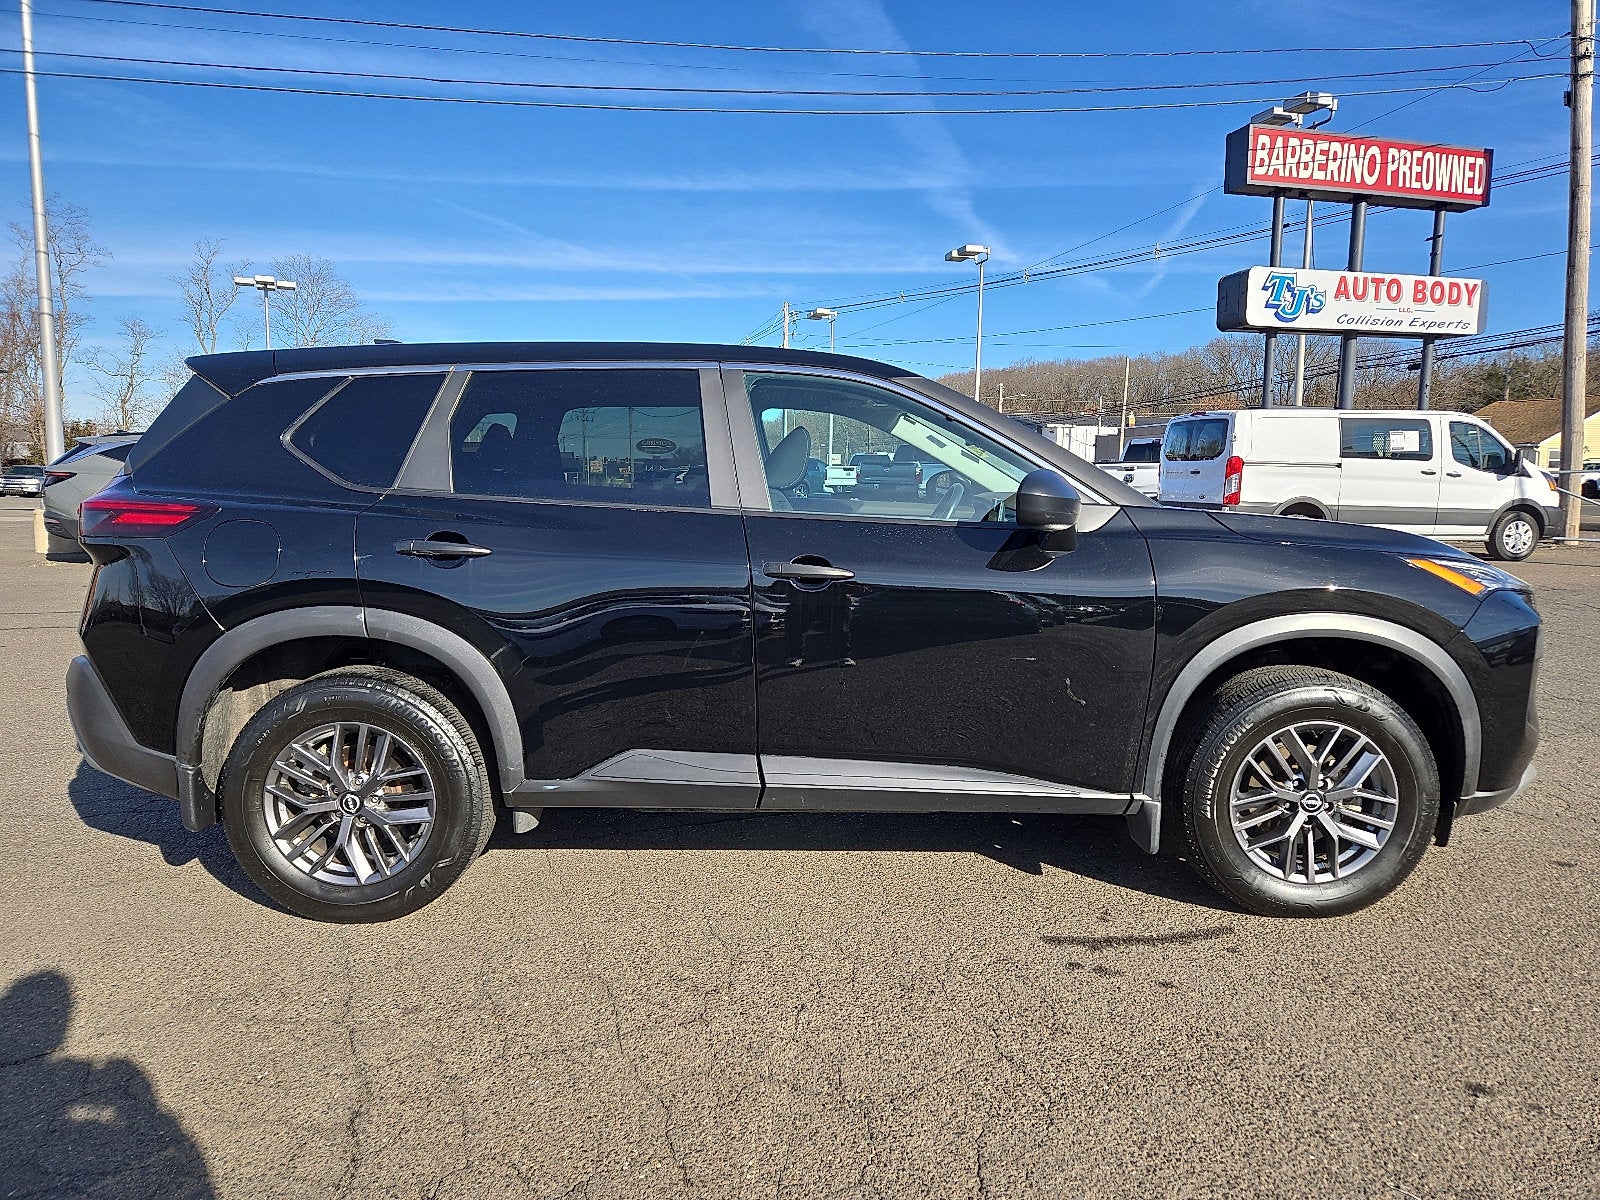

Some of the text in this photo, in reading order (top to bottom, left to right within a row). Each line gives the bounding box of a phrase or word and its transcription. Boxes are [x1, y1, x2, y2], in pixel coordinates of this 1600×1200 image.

[1253, 134, 1487, 195] BARBERINO PREOWNED
[1334, 275, 1479, 307] AUTO BODY
[1336, 313, 1471, 330] Collision Experts
